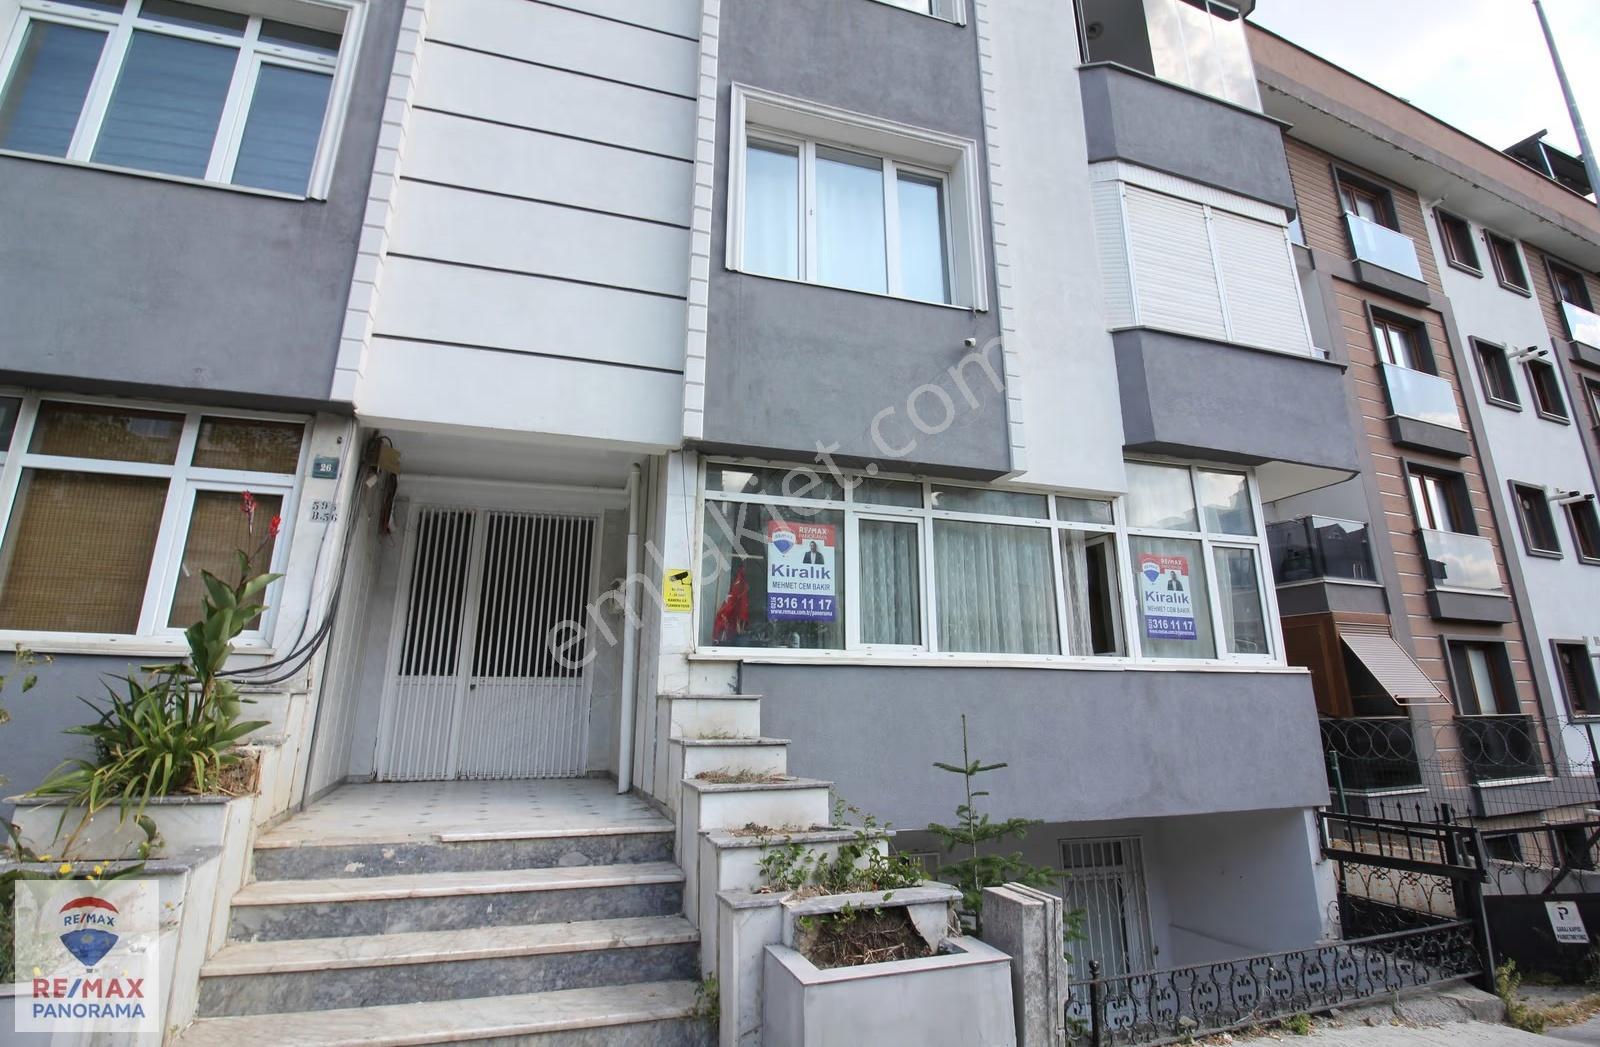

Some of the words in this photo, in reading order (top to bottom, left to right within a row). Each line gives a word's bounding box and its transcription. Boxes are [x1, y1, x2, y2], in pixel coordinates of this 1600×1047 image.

[320, 463, 332, 472] 26
[799, 526, 828, 535] RE/MAX
[771, 564, 831, 579] Kiralık
[772, 581, 798, 589] MEHMET
[799, 582, 812, 590] CEM
[812, 583, 831, 591] BAKIR
[1145, 590, 1189, 604] Kiralık
[776, 597, 798, 609] 316
[801, 598, 814, 610] 11
[819, 599, 832, 610] 17
[1152, 619, 1169, 629] 316
[1170, 620, 1181, 630] 11
[1183, 620, 1193, 630] 17
